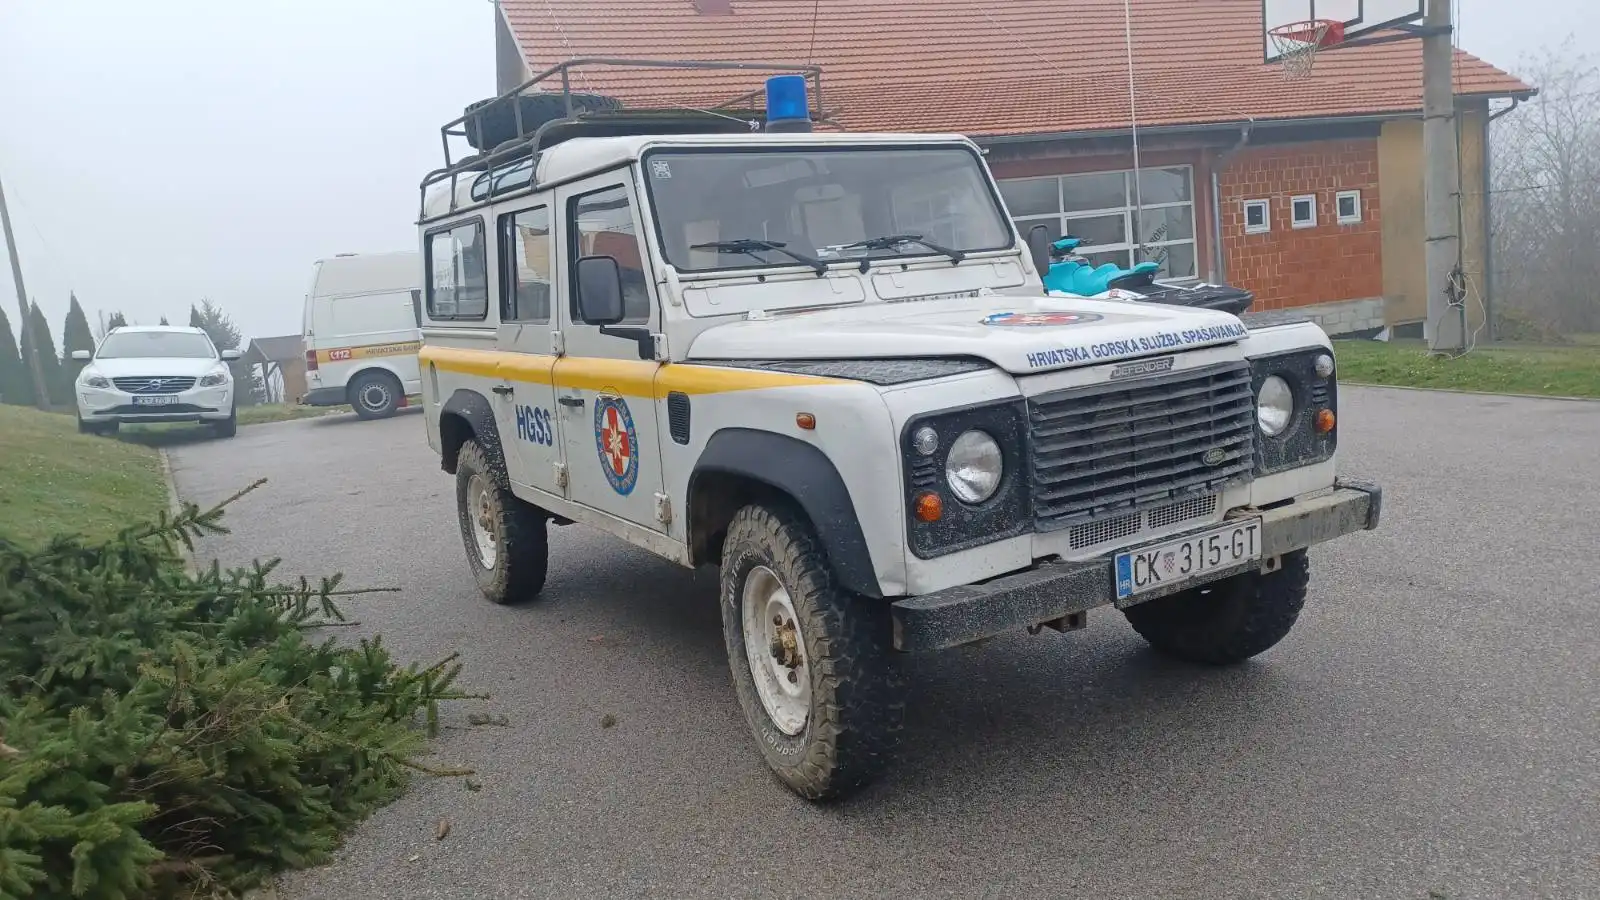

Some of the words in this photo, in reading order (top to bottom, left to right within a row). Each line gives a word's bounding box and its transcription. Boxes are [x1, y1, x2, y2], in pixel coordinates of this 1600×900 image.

[336, 349, 351, 360] 112
[1026, 346, 1091, 368] HRVATSKA
[1092, 338, 1140, 358] GORSKA
[1140, 331, 1182, 351] SLUŽBA
[1182, 323, 1247, 344] SPAŠAVANJA
[1114, 359, 1171, 378] DEFENDER
[515, 404, 553, 447] HGSS
[1180, 524, 1257, 574] 315-GT
[1119, 579, 1131, 591] HR
